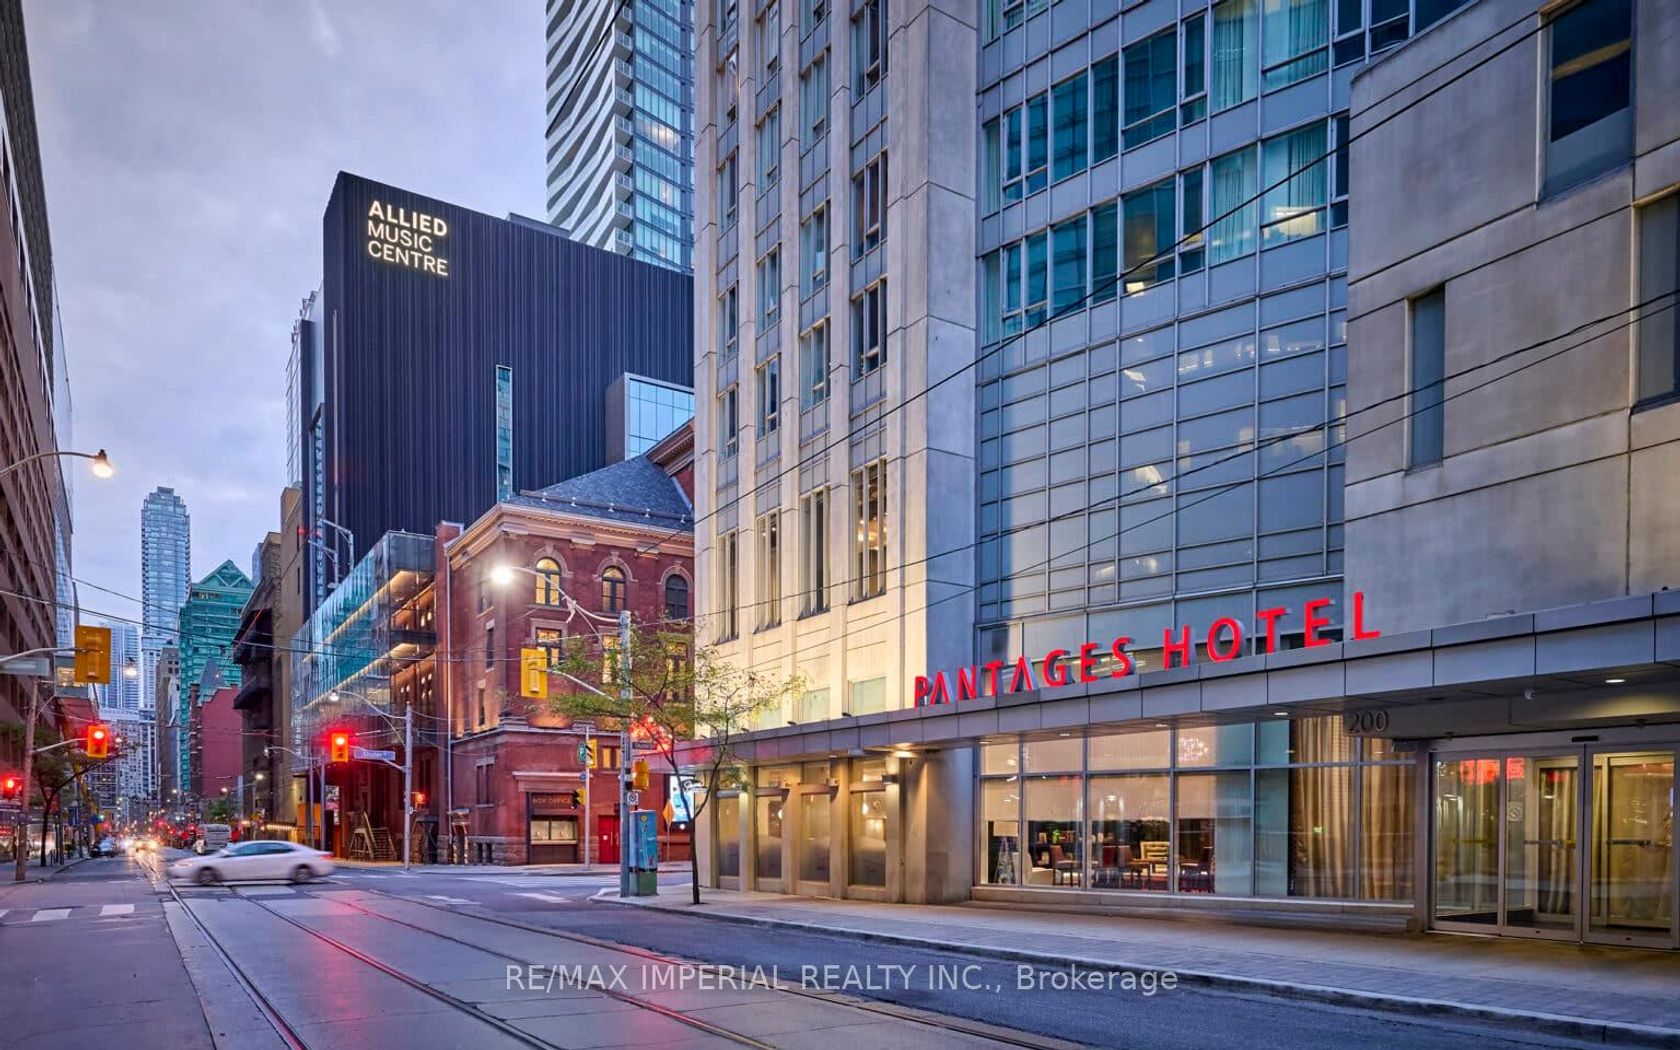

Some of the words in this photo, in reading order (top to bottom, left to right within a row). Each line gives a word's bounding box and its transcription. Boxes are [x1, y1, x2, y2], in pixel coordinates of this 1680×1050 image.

[368, 200, 448, 236] ALLIED
[368, 220, 432, 252] MUSIC
[368, 240, 448, 276] CENTRE
[914, 636, 1136, 707] PANTAGES
[1163, 591, 1380, 669] HOTEL
[1347, 710, 1389, 734] 200
